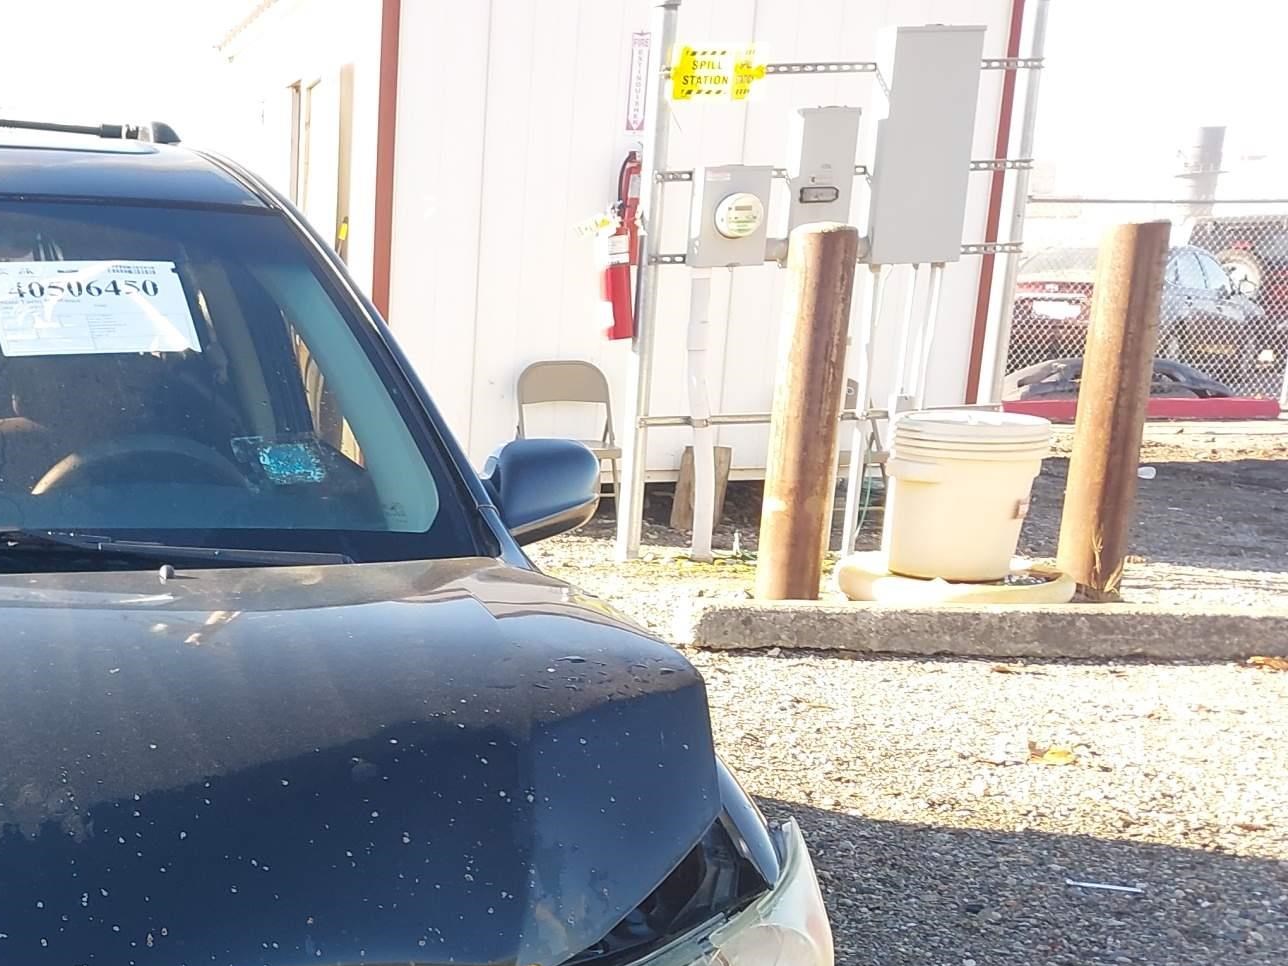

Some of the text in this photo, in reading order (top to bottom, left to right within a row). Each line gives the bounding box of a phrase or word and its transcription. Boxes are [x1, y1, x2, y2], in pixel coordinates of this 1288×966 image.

[692, 60, 722, 70] SPILL
[682, 75, 729, 85] STATION
[8, 279, 159, 298] 40506450
